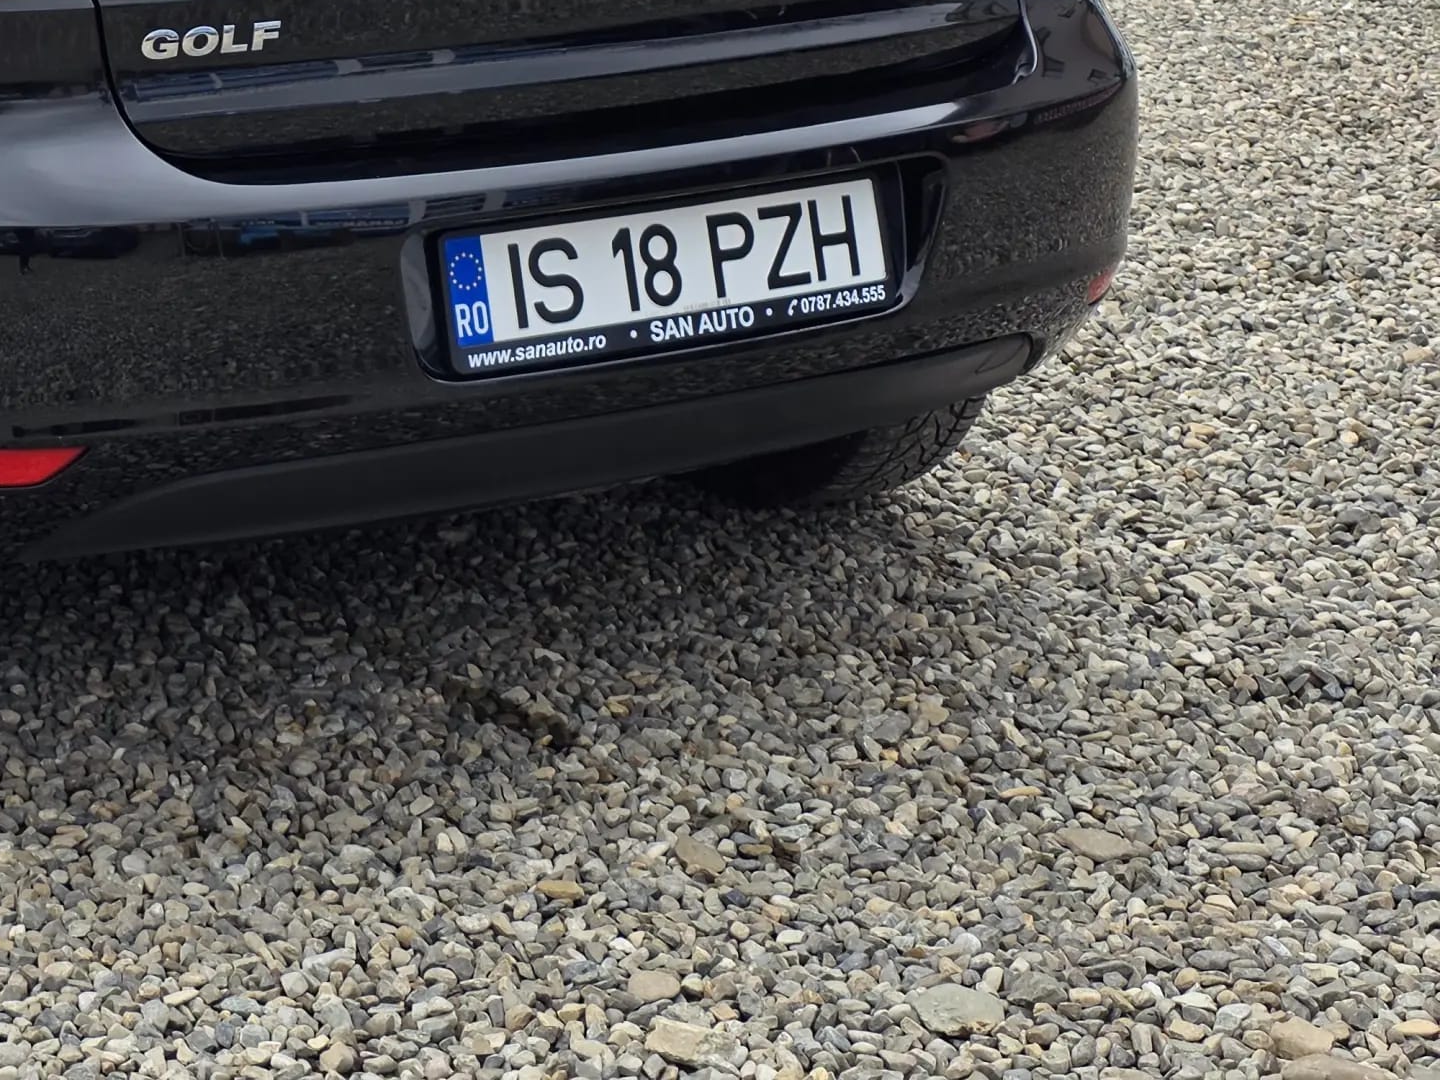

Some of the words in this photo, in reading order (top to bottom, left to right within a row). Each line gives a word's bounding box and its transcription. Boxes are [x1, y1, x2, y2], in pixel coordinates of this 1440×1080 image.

[141, 20, 282, 60] GOLF
[507, 237, 585, 330] IS
[611, 223, 683, 313] 18
[705, 194, 861, 298] PZH
[455, 300, 490, 338] RO
[468, 332, 607, 369] www.sanauto.ro
[650, 313, 694, 342] SAN
[698, 305, 755, 336] AUTO
[800, 284, 887, 315] 0787.434.555
